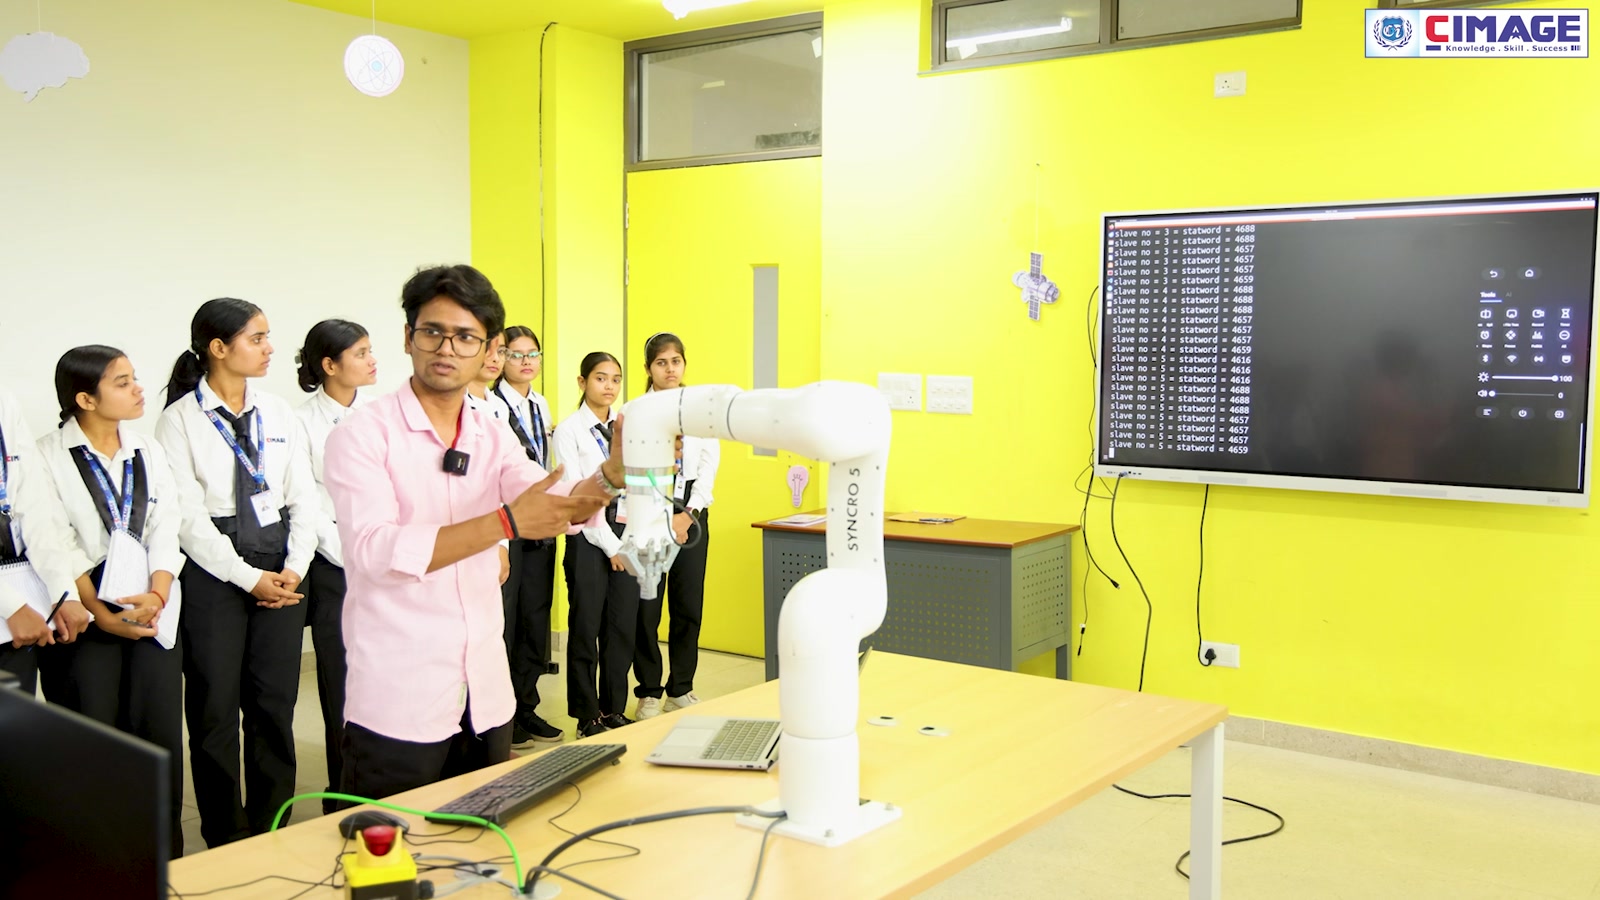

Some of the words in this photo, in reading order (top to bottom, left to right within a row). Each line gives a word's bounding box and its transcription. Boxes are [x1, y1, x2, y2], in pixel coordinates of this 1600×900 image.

[1115, 228, 1138, 237] slave
[1165, 227, 1169, 236] 3
[1183, 225, 1221, 235] statword
[1236, 224, 1255, 233] 4688
[1115, 238, 1137, 247] slave
[1164, 237, 1169, 246] 3
[1183, 235, 1221, 245] statword
[1235, 234, 1255, 243] 4688
[1115, 248, 1137, 257] slave
[1164, 247, 1169, 255] 3
[1183, 245, 1220, 255] statword
[1235, 244, 1254, 254] 4657
[1114, 257, 1137, 266] slave
[1164, 256, 1169, 265] 3
[1182, 255, 1220, 265] statword
[1235, 254, 1254, 264] 4657
[1114, 267, 1136, 276] slave
[1164, 266, 1168, 275] 3
[1182, 265, 1220, 275] statword
[1234, 264, 1254, 274] 4657
[1114, 277, 1136, 286] slave
[1163, 276, 1168, 285] 3
[1182, 275, 1220, 284] statword
[1234, 274, 1253, 284] 4659
[1114, 286, 1136, 295] slave
[1163, 286, 1168, 294] 4
[1182, 285, 1219, 294] statword
[1234, 285, 1253, 294] 4688
[1114, 296, 1136, 305] slave
[1163, 296, 1167, 304] 4
[1181, 295, 1219, 304] statword
[1233, 295, 1253, 304] 4688
[1113, 306, 1135, 314] slave
[1163, 305, 1167, 314] 4
[1181, 305, 1219, 314] statword
[1233, 305, 1252, 314] 4688
[1113, 315, 1135, 324] slave
[1162, 315, 1167, 324] 4
[1181, 315, 1218, 324] statword
[1233, 315, 1252, 324] 4657
[1113, 325, 1135, 334] slave
[1162, 325, 1167, 334] 4
[1180, 325, 1218, 334] statword
[1232, 325, 1252, 334] 4657
[1112, 335, 1135, 343] slave
[1162, 335, 1166, 343] 4
[1180, 335, 1218, 344] statword
[1232, 335, 1251, 344] 4657
[1112, 344, 1134, 353] slave
[1162, 344, 1166, 353] 4
[1180, 345, 1217, 354] statword
[1232, 345, 1251, 354] 4659
[1112, 354, 1134, 362] slave
[1161, 354, 1166, 363] 5
[1180, 354, 1217, 363] statword
[1231, 355, 1251, 364] 4616
[1112, 363, 1134, 372] slave
[1161, 364, 1166, 373] 5
[1179, 364, 1217, 373] statword
[1231, 365, 1250, 374] 4616
[1112, 373, 1134, 382] slave
[1161, 374, 1165, 382] 5
[1179, 374, 1216, 383] statword
[1231, 375, 1250, 384] 4616
[1111, 382, 1133, 391] slave
[1160, 383, 1165, 392] 5
[1179, 384, 1216, 393] statword
[1230, 385, 1250, 394] 4688
[1111, 392, 1133, 401] slave
[1160, 393, 1165, 402] 5
[1178, 394, 1216, 403] statword
[1230, 395, 1249, 404] 4688
[1111, 402, 1133, 410] slave
[1160, 403, 1164, 411] 5
[1178, 403, 1216, 413] statword
[1230, 405, 1249, 414] 4688
[1110, 411, 1132, 420] slave
[1160, 412, 1164, 421] 5
[1178, 413, 1215, 423] statword
[1230, 414, 1249, 424] 4657
[1110, 420, 1132, 430] slave
[1159, 422, 1164, 431] 5
[1178, 423, 1215, 433] statword
[1229, 424, 1248, 434] 4657
[1110, 430, 1132, 439] slave
[1159, 432, 1164, 440] 5
[1177, 432, 1215, 442] statword
[1229, 434, 1248, 444] 4657
[1110, 440, 1132, 449] slave
[1159, 442, 1163, 450] 5
[1177, 442, 1214, 452] statword
[1229, 444, 1248, 454] 4659
[850, 468, 860, 476] 5
[847, 483, 859, 551] SYNCRO
